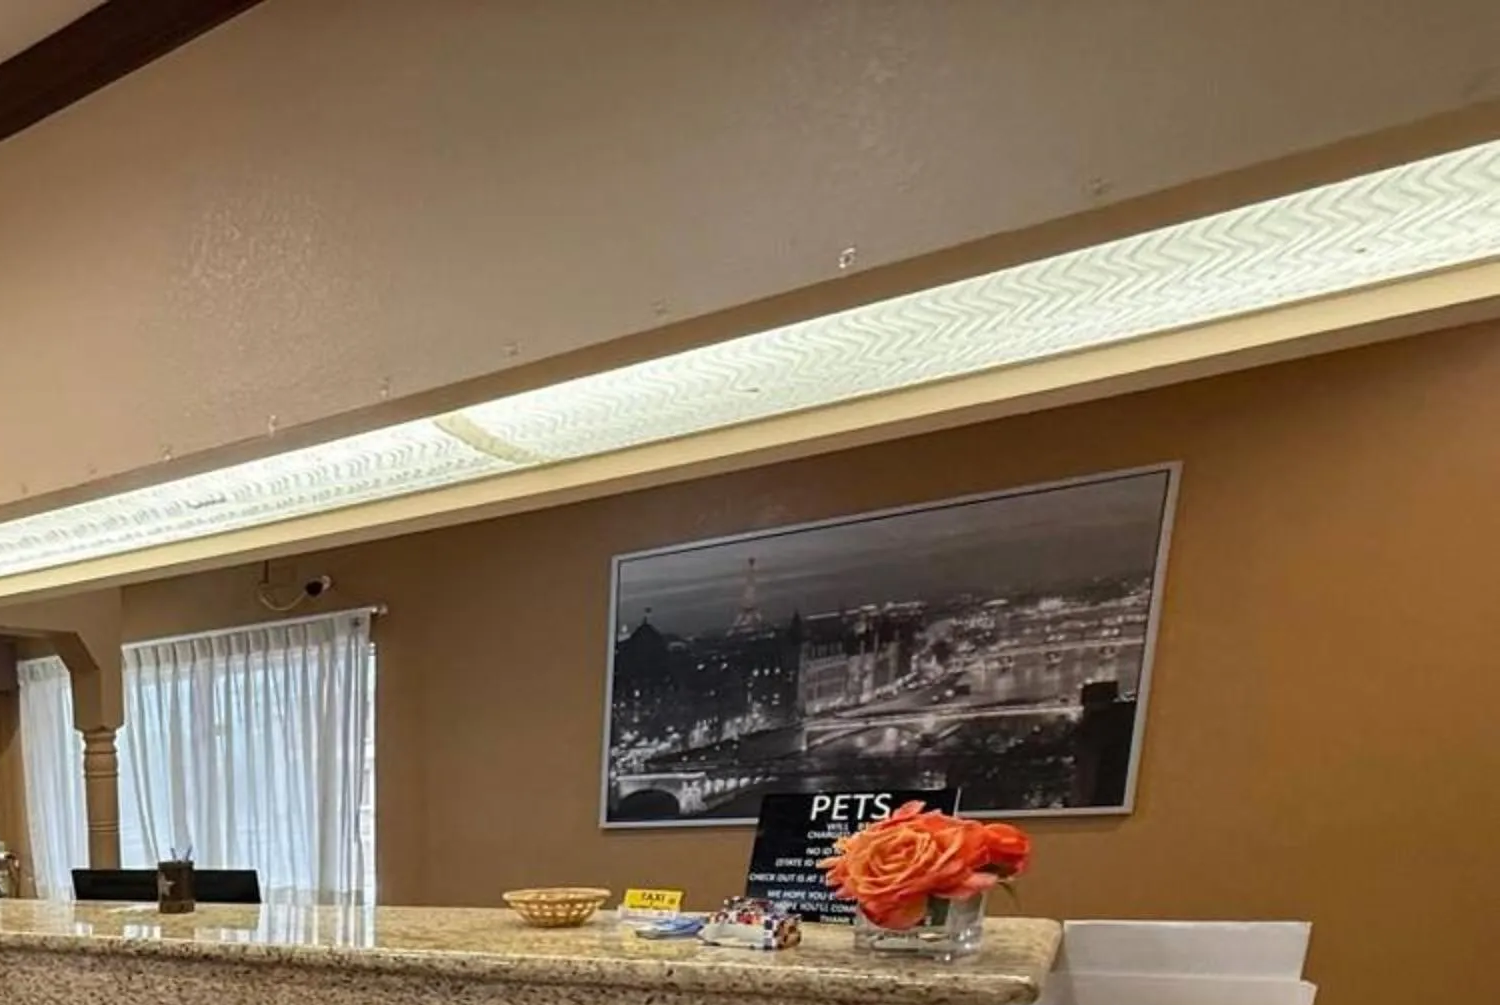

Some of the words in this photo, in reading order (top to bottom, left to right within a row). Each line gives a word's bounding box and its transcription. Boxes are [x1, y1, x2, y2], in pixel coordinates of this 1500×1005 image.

[809, 793, 893, 821] PETS
[749, 873, 775, 882] CHECK
[777, 873, 795, 882] OUT
[782, 890, 806, 900] HOPE
[808, 891, 827, 901] YOU
